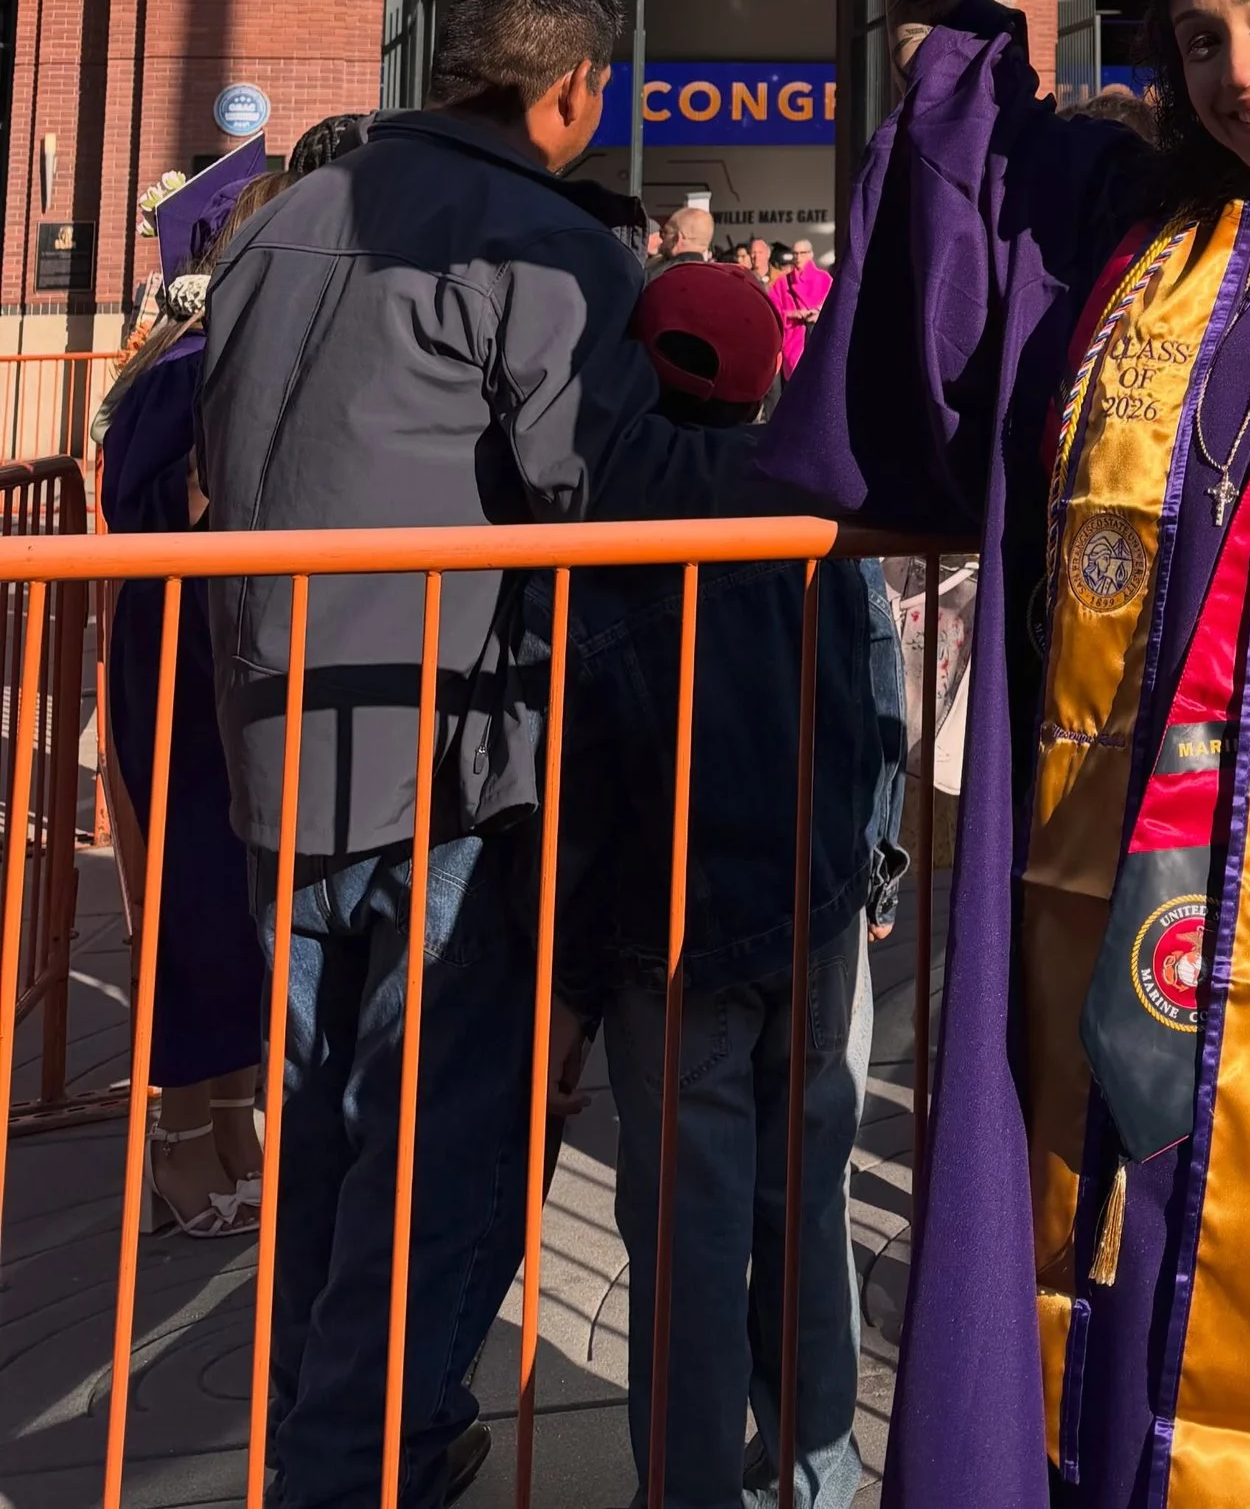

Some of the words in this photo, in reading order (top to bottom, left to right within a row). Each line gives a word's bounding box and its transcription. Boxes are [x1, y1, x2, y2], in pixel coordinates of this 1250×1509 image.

[713, 210, 755, 225] WILLIE
[758, 209, 794, 224] MAYS
[797, 208, 829, 223] GATE
[1108, 335, 1192, 365] CLASS
[1118, 366, 1158, 389] OF
[1102, 395, 1159, 422] 2026
[1089, 595, 1116, 607] 1899
[1160, 904, 1209, 928] UNITED
[1140, 967, 1180, 1019] MARINE
